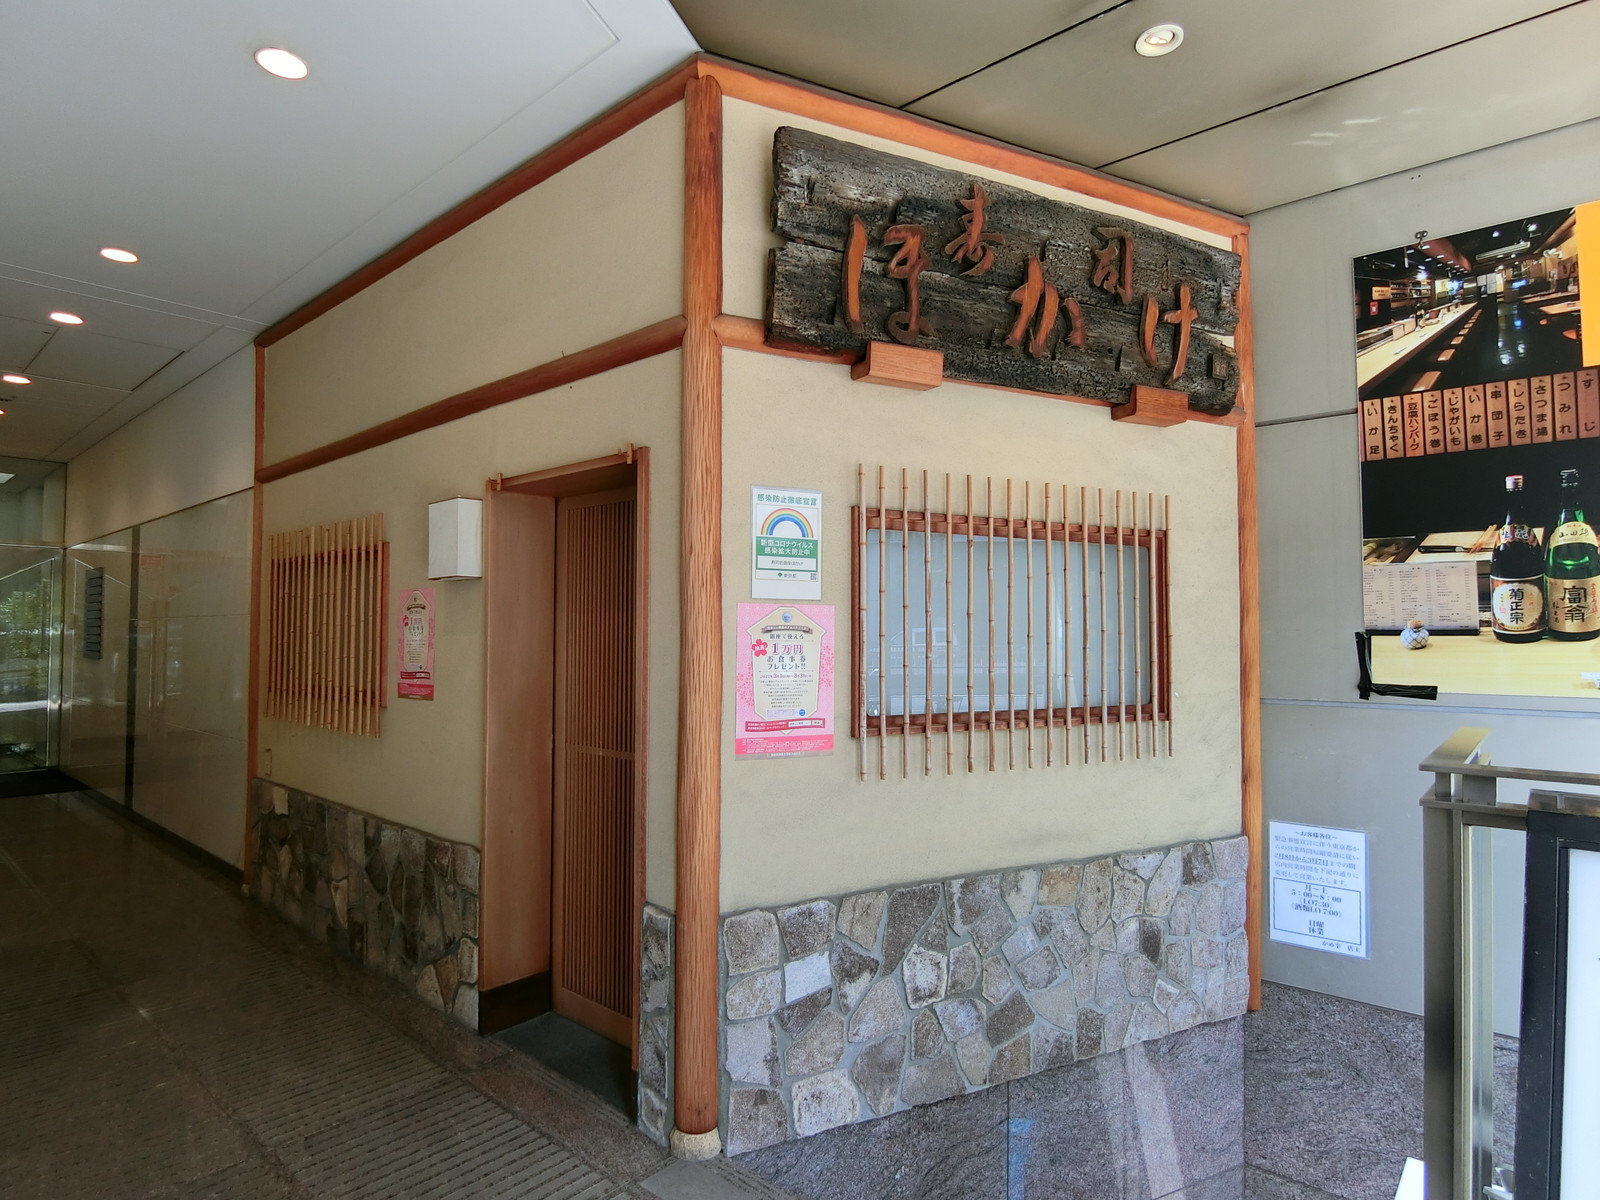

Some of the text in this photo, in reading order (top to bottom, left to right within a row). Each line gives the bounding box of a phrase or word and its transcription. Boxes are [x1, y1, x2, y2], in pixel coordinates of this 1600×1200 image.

[1388, 406, 1398, 452] きんちゃく
[1407, 403, 1419, 451] 豆腐ハンバーグ
[1428, 399, 1441, 448] ごぼう巻
[1448, 398, 1461, 445] じゃがいも
[1469, 394, 1482, 444] いか巻
[1491, 390, 1504, 440] 串団子
[1513, 388, 1526, 438] しらたき
[1535, 385, 1548, 436] さつま揚
[1558, 383, 1572, 434] つみれ
[1583, 379, 1596, 432] すじ
[1367, 407, 1380, 455] いか足
[758, 494, 817, 506] 感染防止徹底宣言
[761, 539, 813, 548] 新型コロナウイルス
[765, 547, 810, 556] 感染拡大防止中
[1509, 588, 1524, 624] 菊正宗
[1560, 585, 1587, 622] 富翁
[772, 643, 803, 655] 1万円
